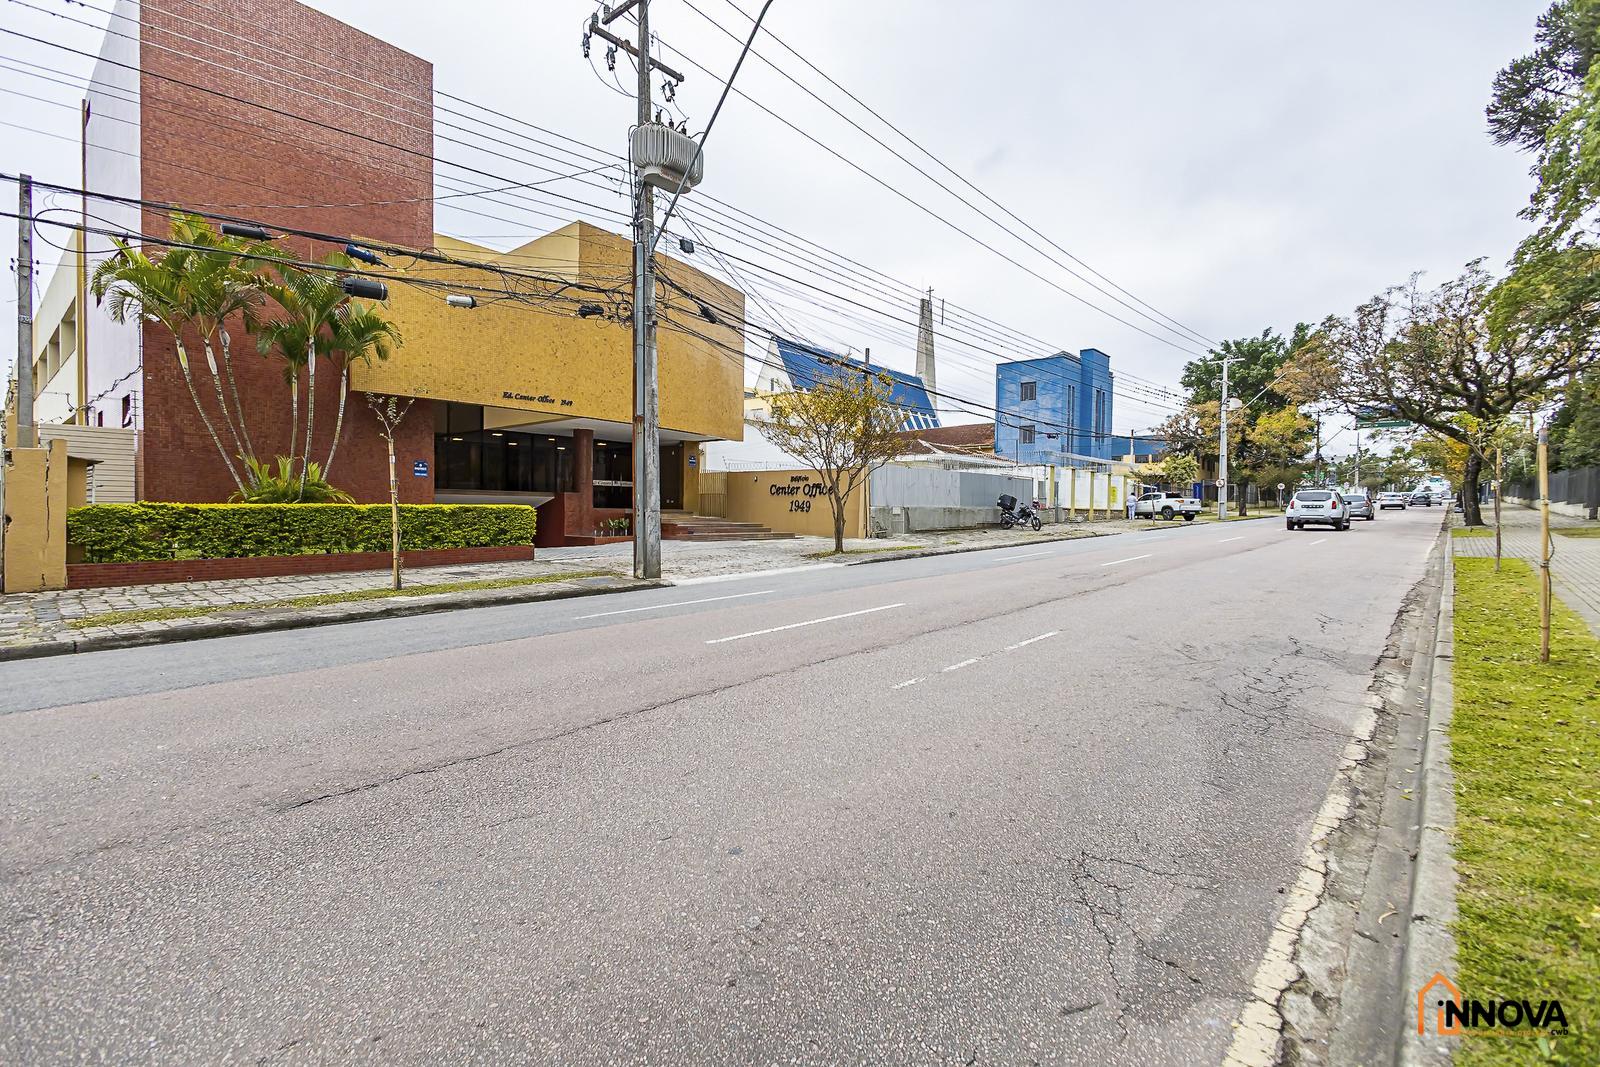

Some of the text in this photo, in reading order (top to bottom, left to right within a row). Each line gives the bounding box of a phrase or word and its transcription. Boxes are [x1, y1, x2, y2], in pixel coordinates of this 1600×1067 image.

[515, 393, 536, 402] Center
[537, 394, 555, 404] Office
[769, 482, 834, 498] Center Office
[788, 499, 811, 513] 1949
